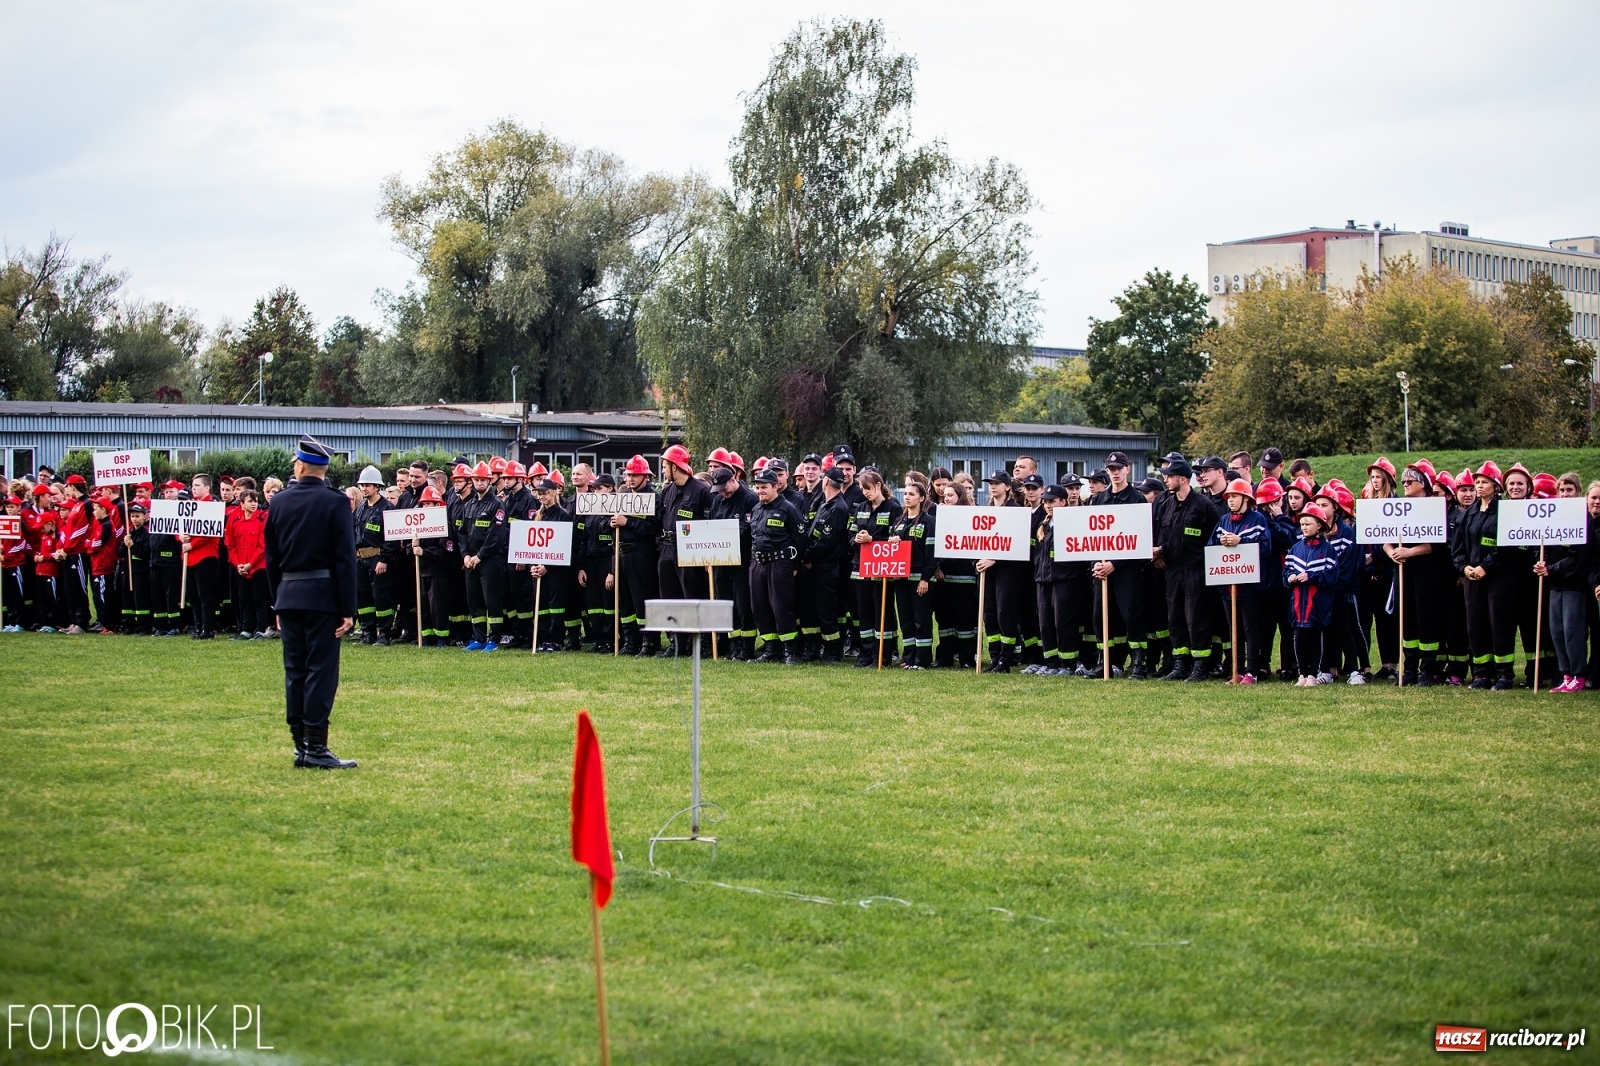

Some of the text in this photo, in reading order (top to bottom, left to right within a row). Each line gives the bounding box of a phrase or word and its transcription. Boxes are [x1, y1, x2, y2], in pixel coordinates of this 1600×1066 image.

[113, 454, 131, 465] OSP
[97, 466, 149, 479] PIETRASZYN
[177, 501, 198, 517] OSP
[578, 494, 597, 514] OSP
[1382, 502, 1412, 517] OSP
[1527, 503, 1556, 518] OSP
[149, 517, 223, 536] NOWA WIOSKA
[404, 513, 426, 526] OSP
[972, 515, 997, 531] OSP
[1089, 514, 1115, 531] OSP
[527, 527, 555, 548] OSP
[1364, 524, 1443, 538] GÓRKI ŚLĄSKIE
[1508, 526, 1584, 541] GÓRKI ŚLĄSKIE
[944, 532, 1012, 552] SŁAWIKÓW
[1065, 532, 1138, 553] SŁAWIKÓW
[514, 551, 565, 561] PIETROWICE WIELKIE
[872, 543, 899, 557] OSP
[1221, 553, 1241, 563] OSP
[863, 561, 906, 576] TURZE
[1209, 563, 1255, 576] ZABEŁKÓW
